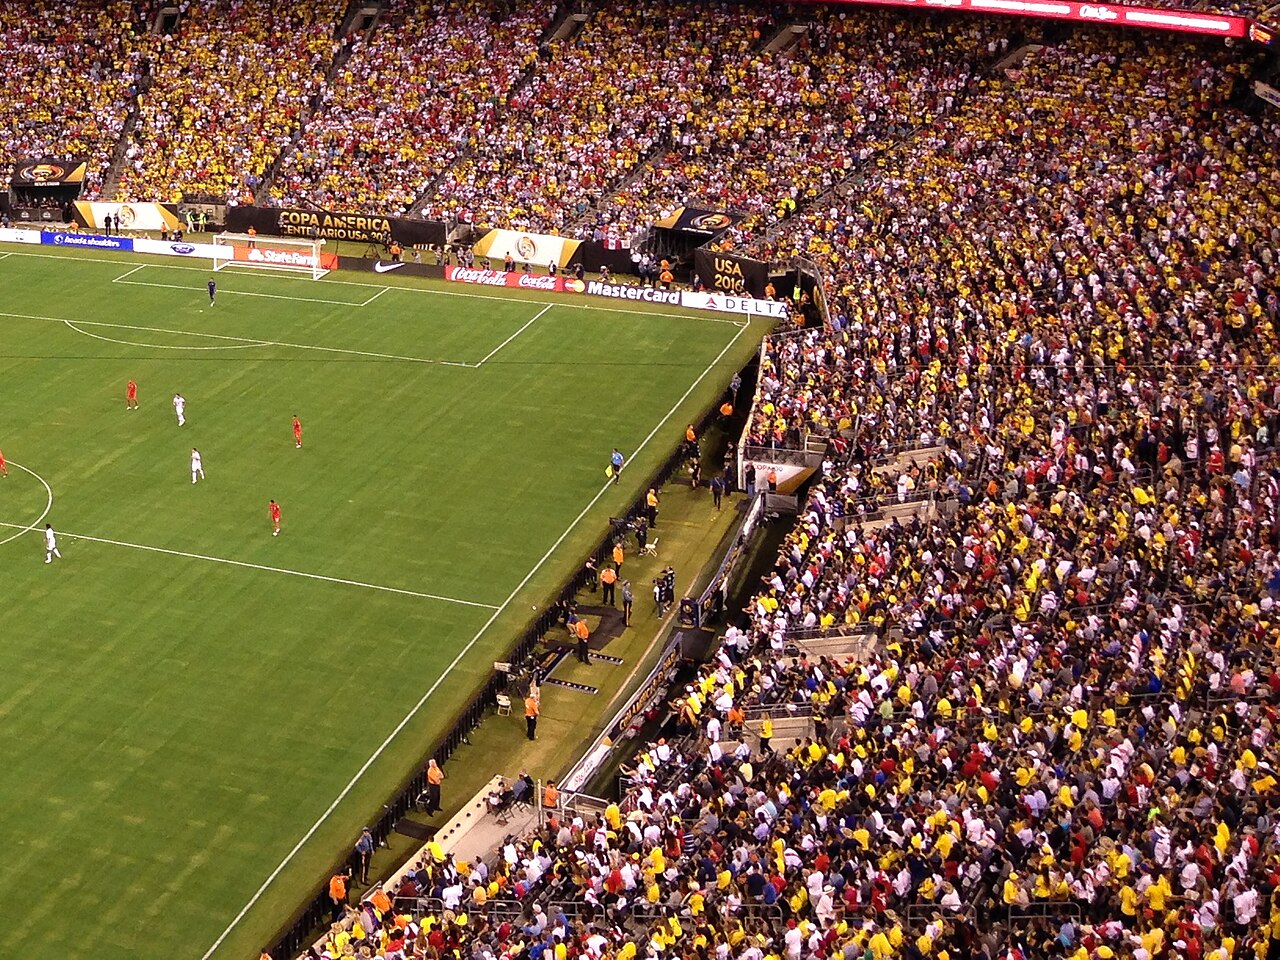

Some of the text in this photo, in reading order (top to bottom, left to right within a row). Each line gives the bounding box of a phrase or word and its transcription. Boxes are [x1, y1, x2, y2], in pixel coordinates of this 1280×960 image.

[280, 211, 392, 233] COPA AMERICA
[714, 257, 742, 276] USA
[587, 280, 680, 305] MasterCard
[714, 273, 743, 293] 2016
[725, 297, 789, 316] DELTA
